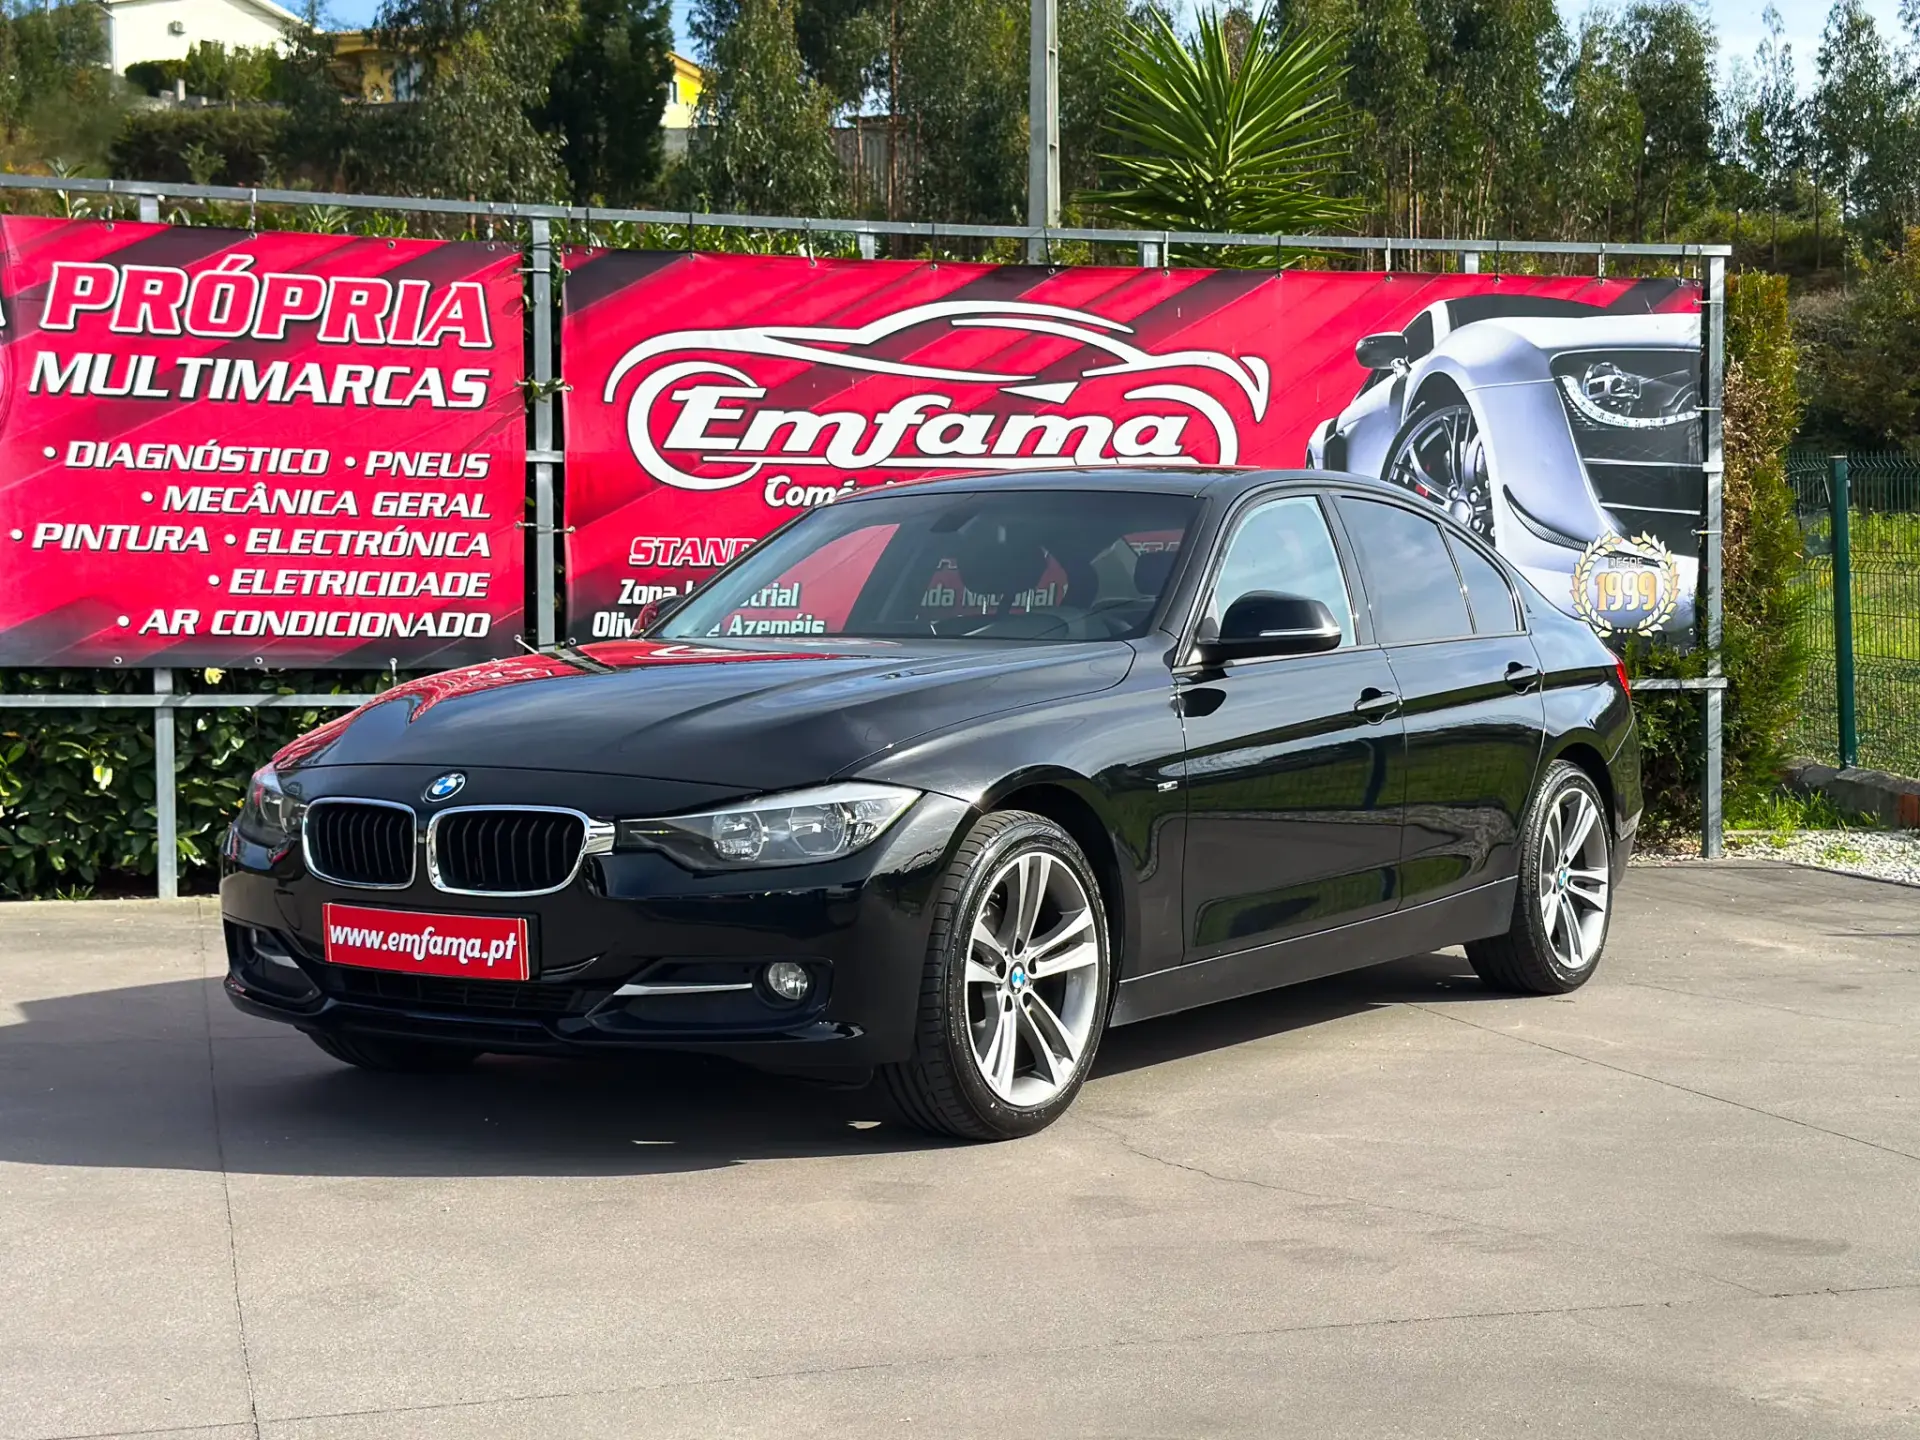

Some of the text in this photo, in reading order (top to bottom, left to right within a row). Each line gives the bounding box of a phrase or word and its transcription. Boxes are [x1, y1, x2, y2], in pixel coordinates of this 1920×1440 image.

[40, 254, 493, 347] PRÓPRIA
[28, 350, 491, 408] MULTIMARCAS
[662, 384, 1187, 467] Emfama
[65, 439, 490, 478] DIAGNÓSTICO PNEUS
[162, 482, 490, 518] MECÂNICA GERAL
[32, 522, 490, 557] PINTURA ELECTRÓNICA
[229, 568, 490, 598] ELETRICIDADE
[1595, 571, 1657, 611] 1999
[139, 609, 490, 638] AR CONDICIONADO
[330, 925, 517, 966] www.emfama.pt
